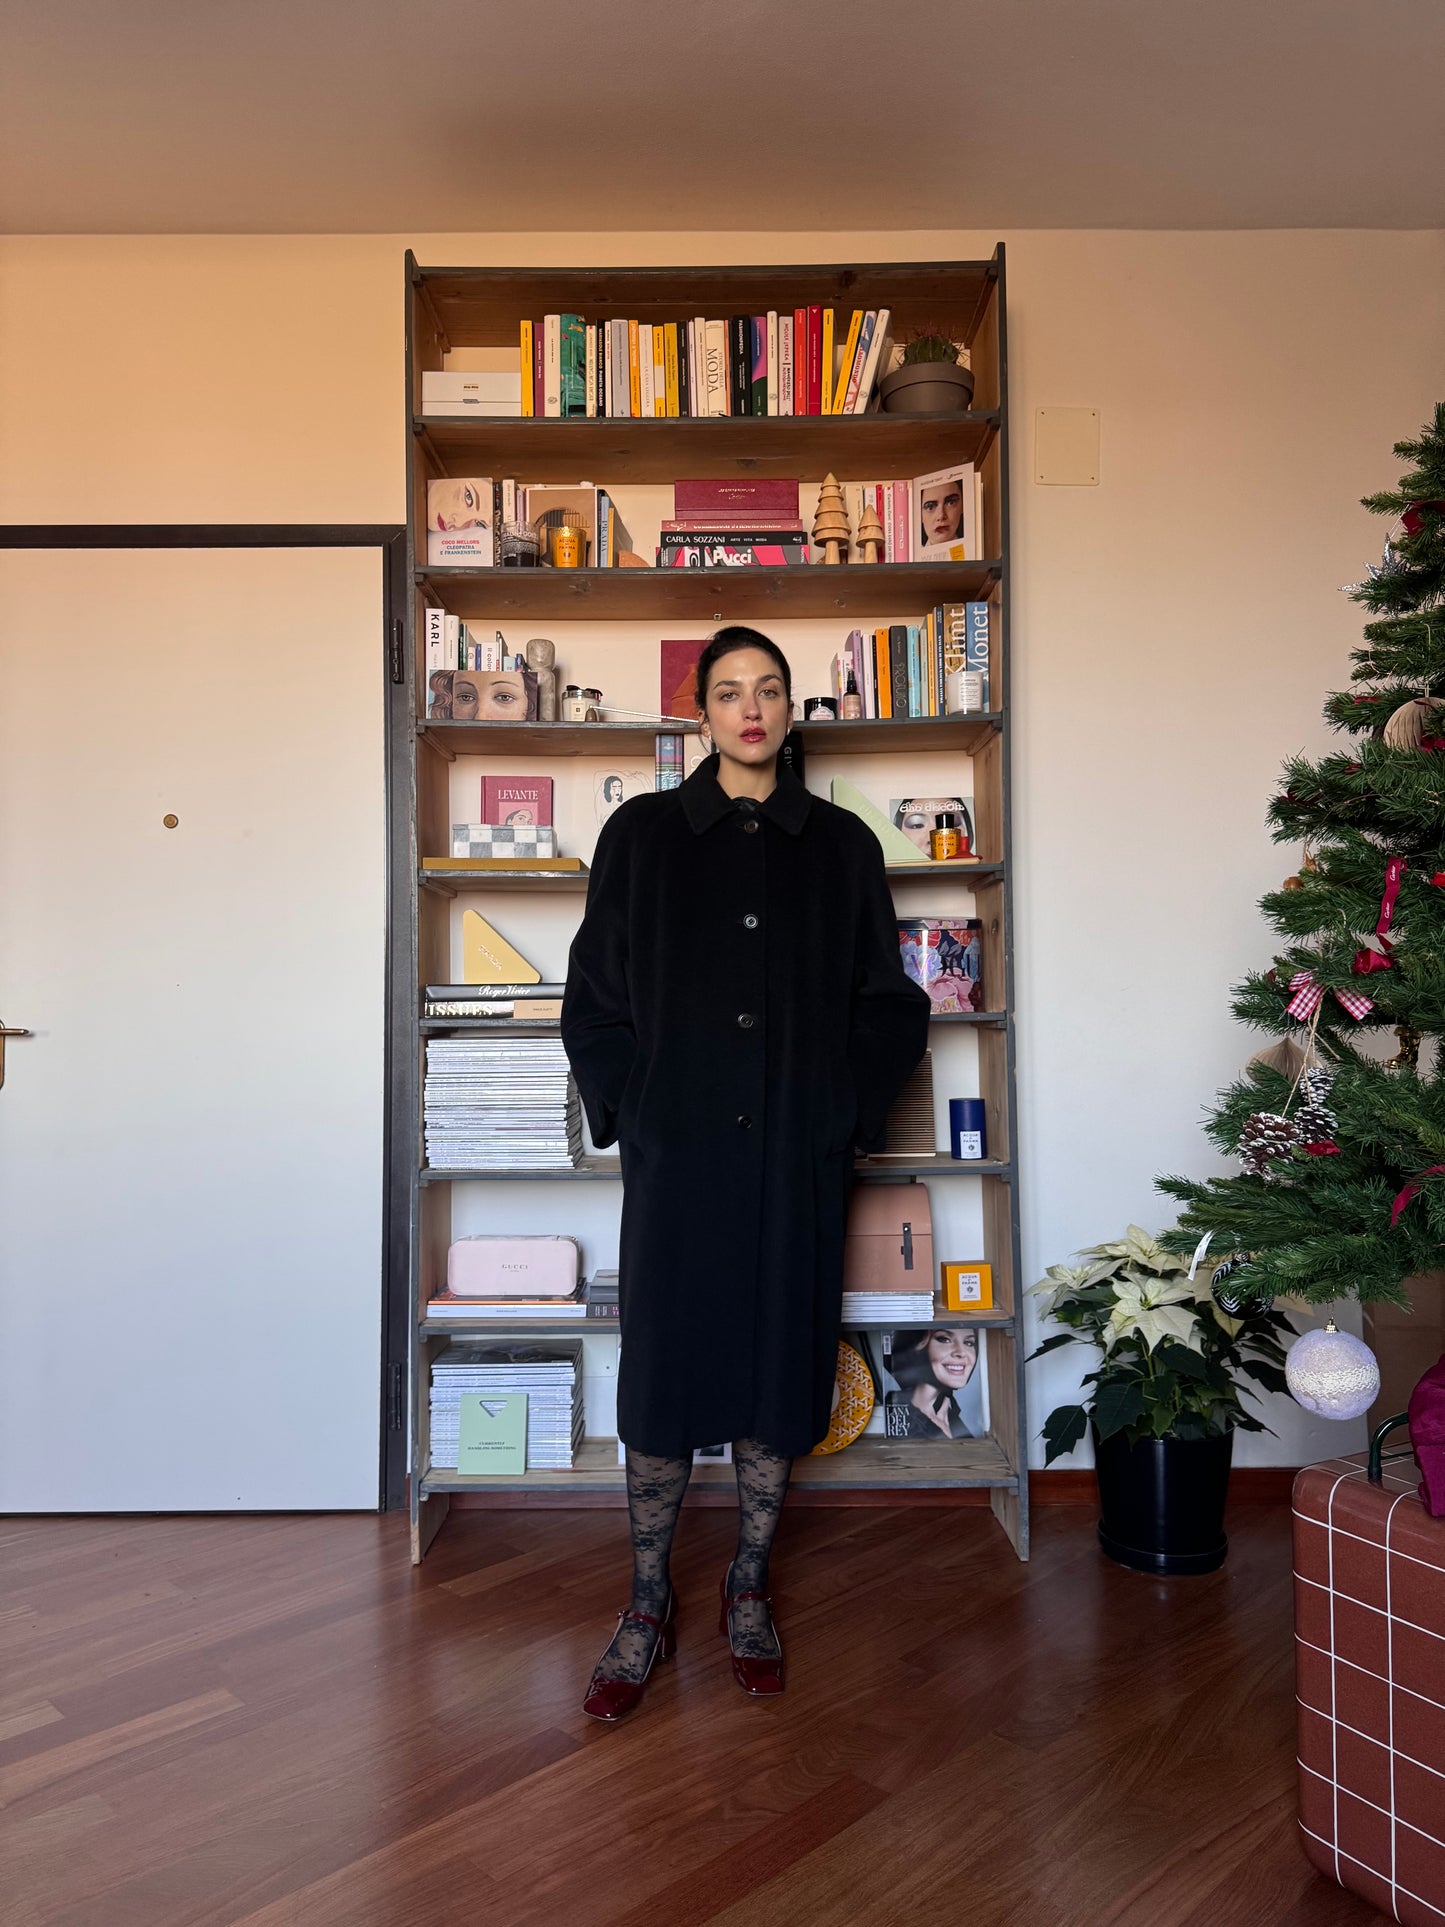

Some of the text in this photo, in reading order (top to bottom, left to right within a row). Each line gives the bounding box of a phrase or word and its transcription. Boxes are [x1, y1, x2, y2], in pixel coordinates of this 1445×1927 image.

[706, 348, 719, 393] MODA
[713, 548, 752, 564] Pucci
[431, 613, 440, 647] KARL
[945, 608, 966, 673] Klimt
[967, 606, 989, 681] Monet
[498, 789, 539, 801] LEVANTE
[478, 985, 530, 997] Roger Vivier
[428, 1004, 493, 1016] ISSUES
[886, 1407, 910, 1416] LANA
[887, 1415, 908, 1426] DEL
[887, 1424, 910, 1436] REY
